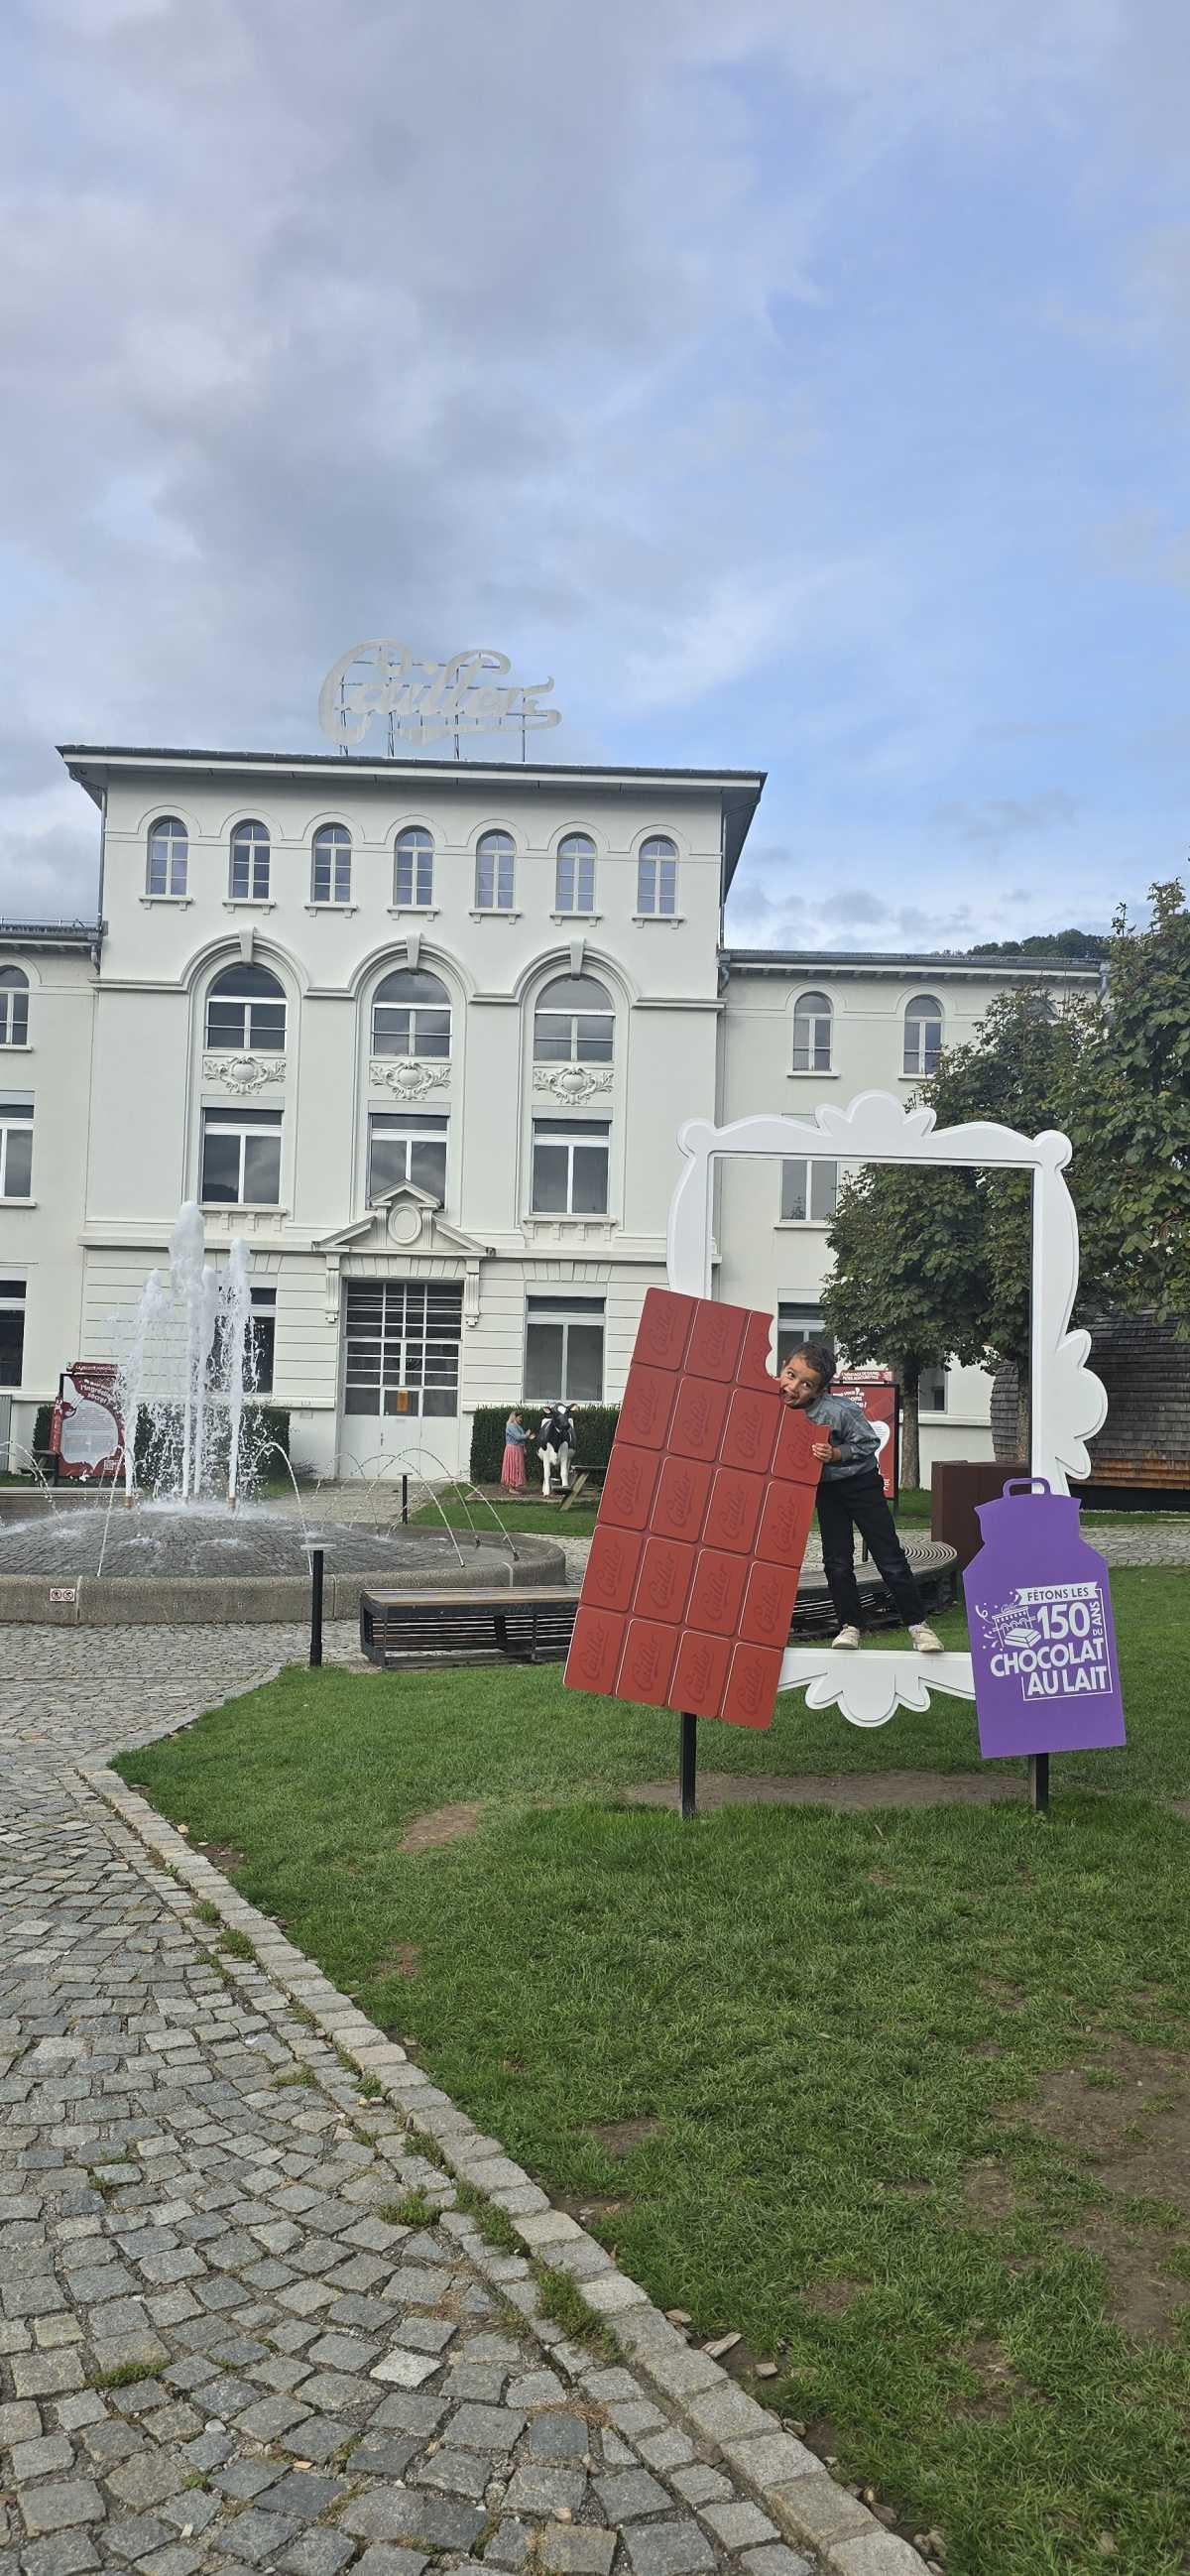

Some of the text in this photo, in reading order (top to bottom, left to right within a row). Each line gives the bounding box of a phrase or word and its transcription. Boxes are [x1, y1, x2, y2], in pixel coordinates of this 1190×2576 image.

[318, 638, 562, 746] Cailler
[1027, 1587, 1089, 1602] FÊTONS LES
[1037, 1602, 1090, 1640] 150
[1090, 1601, 1103, 1626] ANS
[990, 1638, 1104, 1677] CHOCOLAT
[1026, 1665, 1107, 1696] AU LAIT
